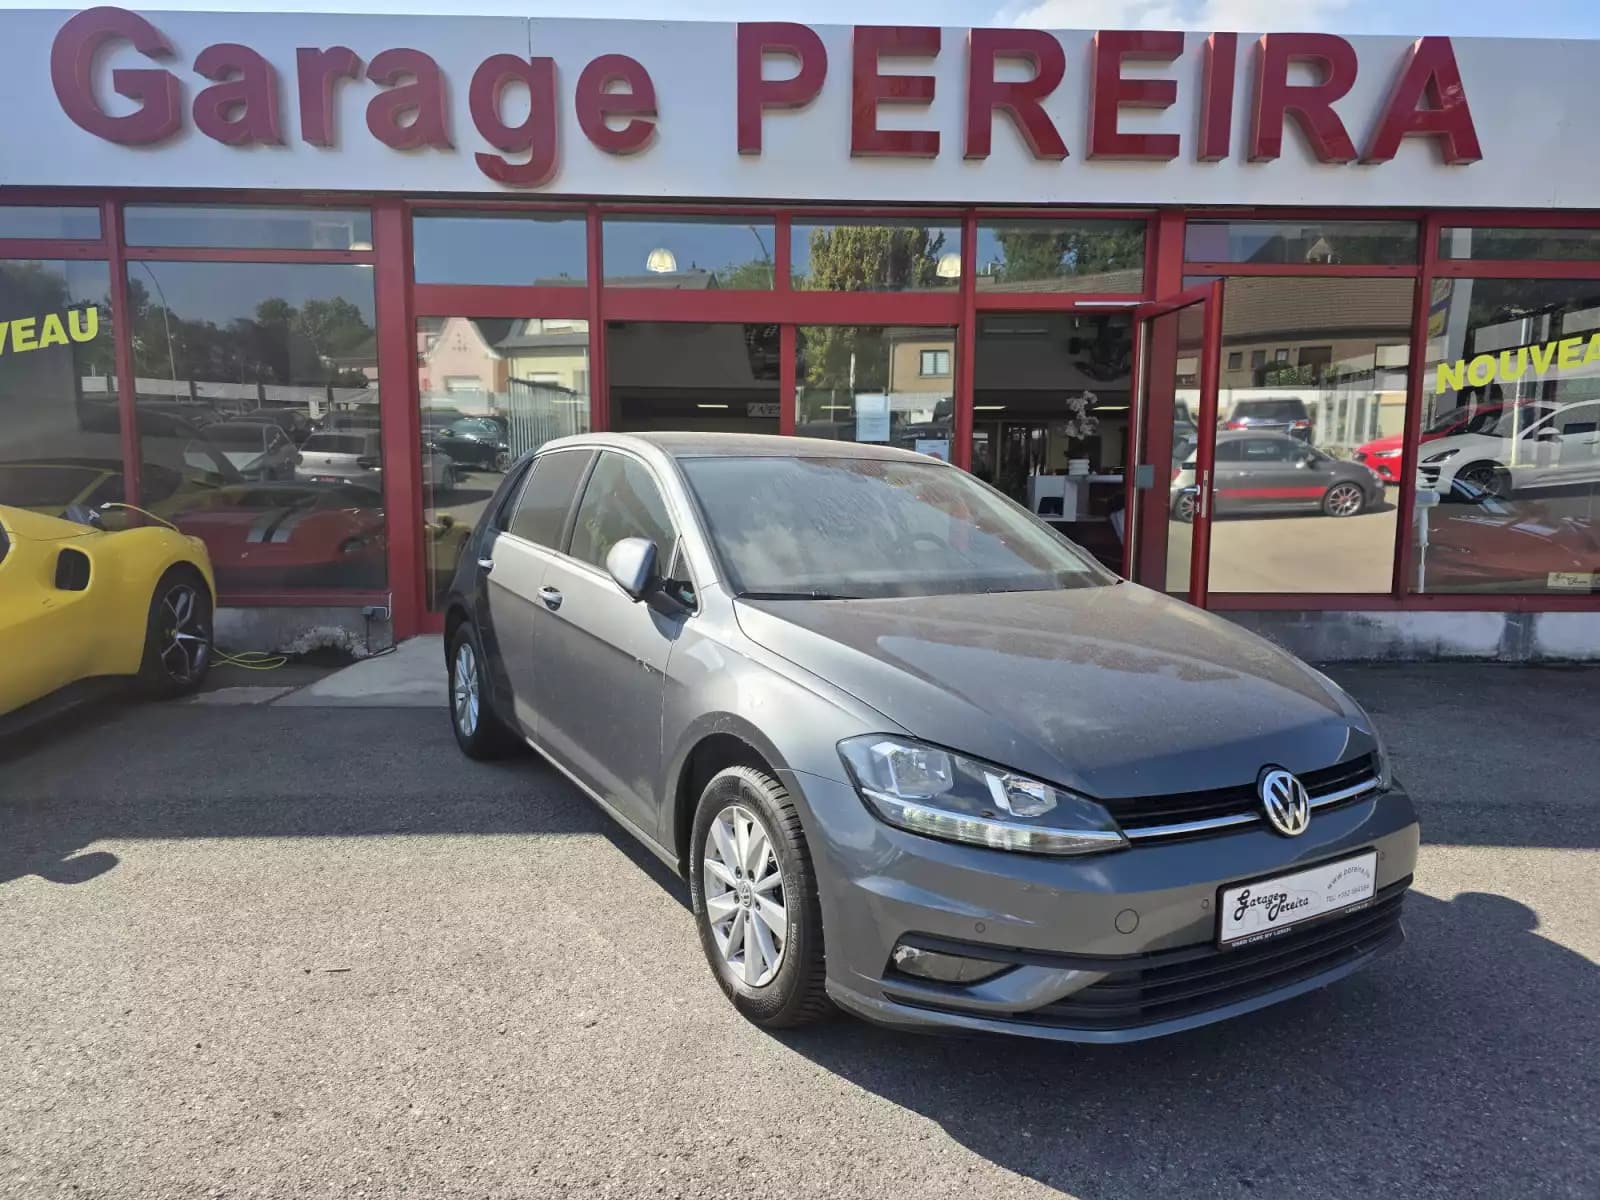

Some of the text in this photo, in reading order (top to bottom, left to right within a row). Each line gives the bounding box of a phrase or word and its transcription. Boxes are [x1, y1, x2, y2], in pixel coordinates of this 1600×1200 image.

[51, 6, 1483, 188] Garage PEREIRA
[1234, 889, 1280, 921] Garage
[1268, 893, 1309, 921] Pereira
